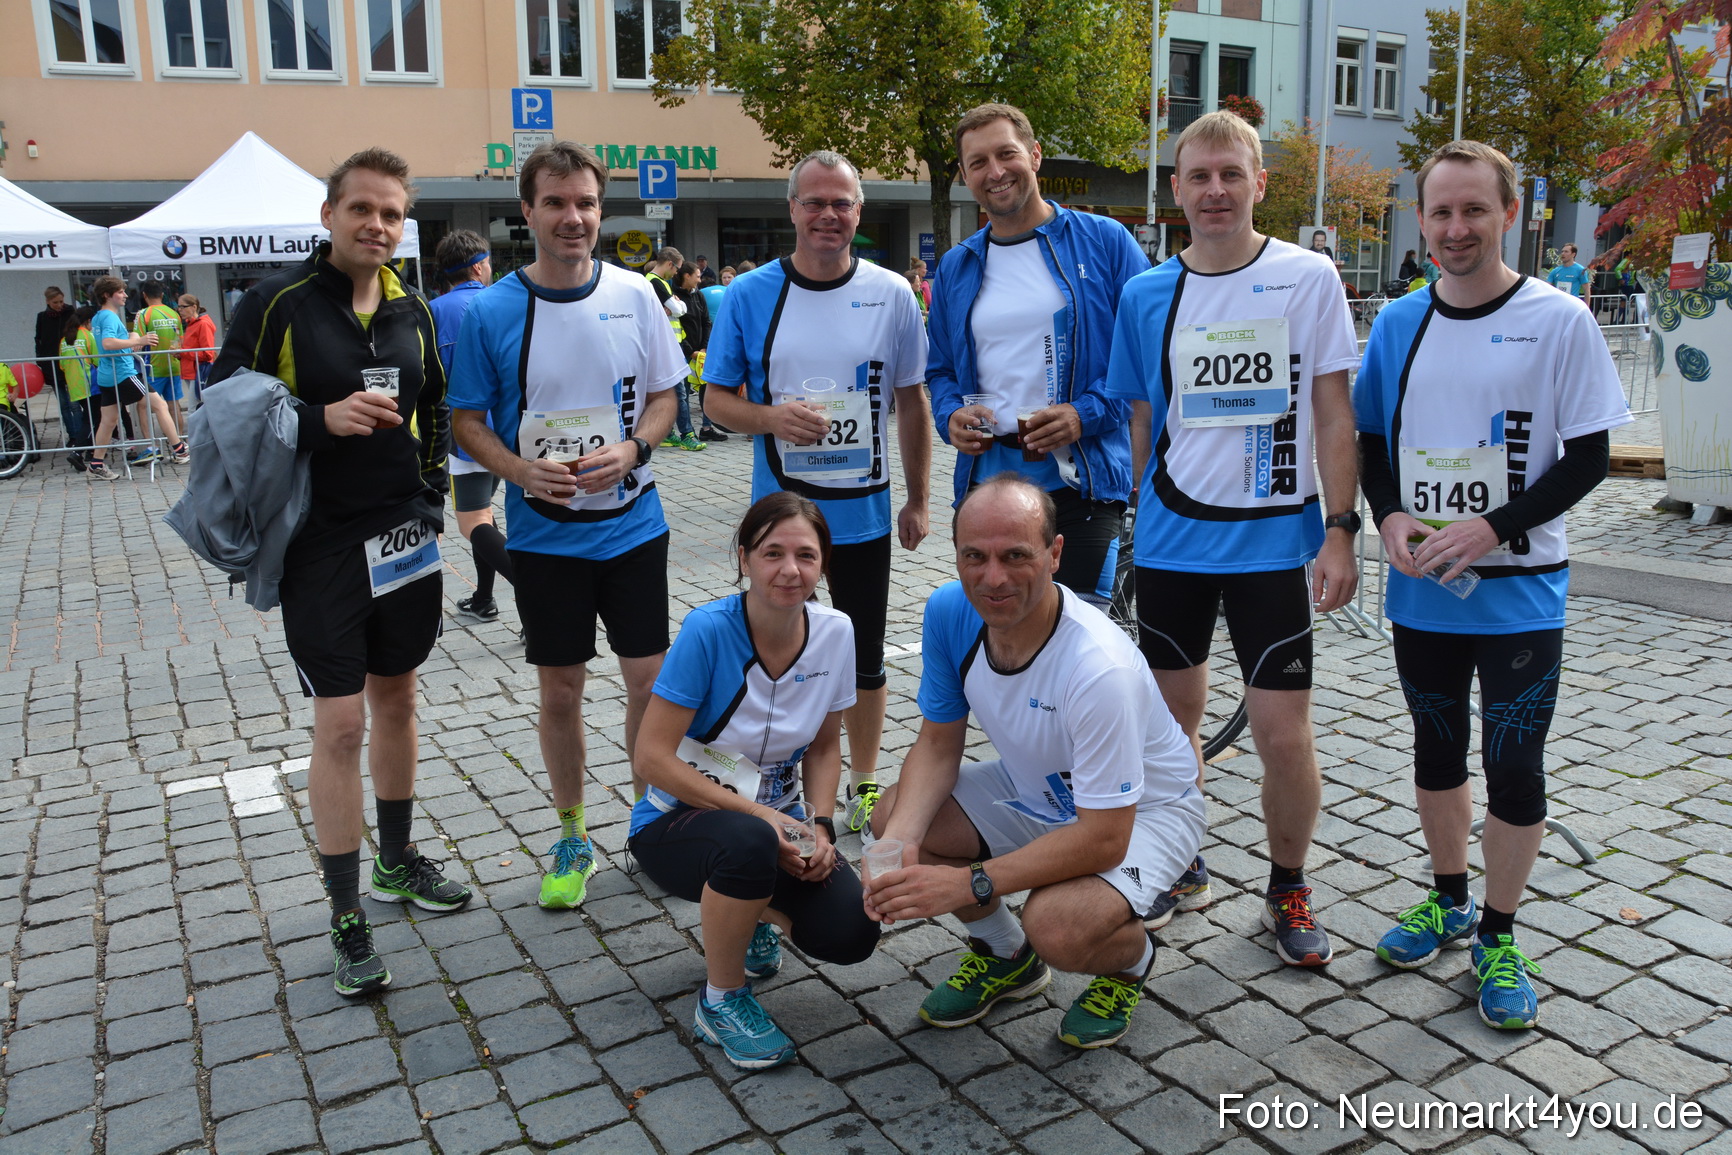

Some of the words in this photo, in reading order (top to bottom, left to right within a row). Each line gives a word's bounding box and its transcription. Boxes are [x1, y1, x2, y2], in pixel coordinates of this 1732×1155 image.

[521, 93, 543, 125] P
[648, 165, 668, 195] P
[1536, 180, 1545, 199] P
[0, 241, 58, 263] port
[200, 235, 263, 255] BMW
[269, 234, 330, 254] Lauf
[1217, 329, 1256, 341] BOCK
[1044, 334, 1053, 365] WASTE
[1193, 352, 1273, 387] 2028
[1046, 367, 1054, 398] WATER
[1212, 396, 1256, 409] Thomas
[556, 415, 590, 427] BOCK
[807, 454, 848, 466] Christian
[1434, 457, 1471, 468] BOCK
[1244, 456, 1253, 493] Solutions
[1413, 481, 1490, 514] 5149
[379, 521, 430, 558] 2064
[394, 552, 424, 574] Manfred
[712, 751, 738, 770] BOCK
[1120, 867, 1143, 890] adidas
